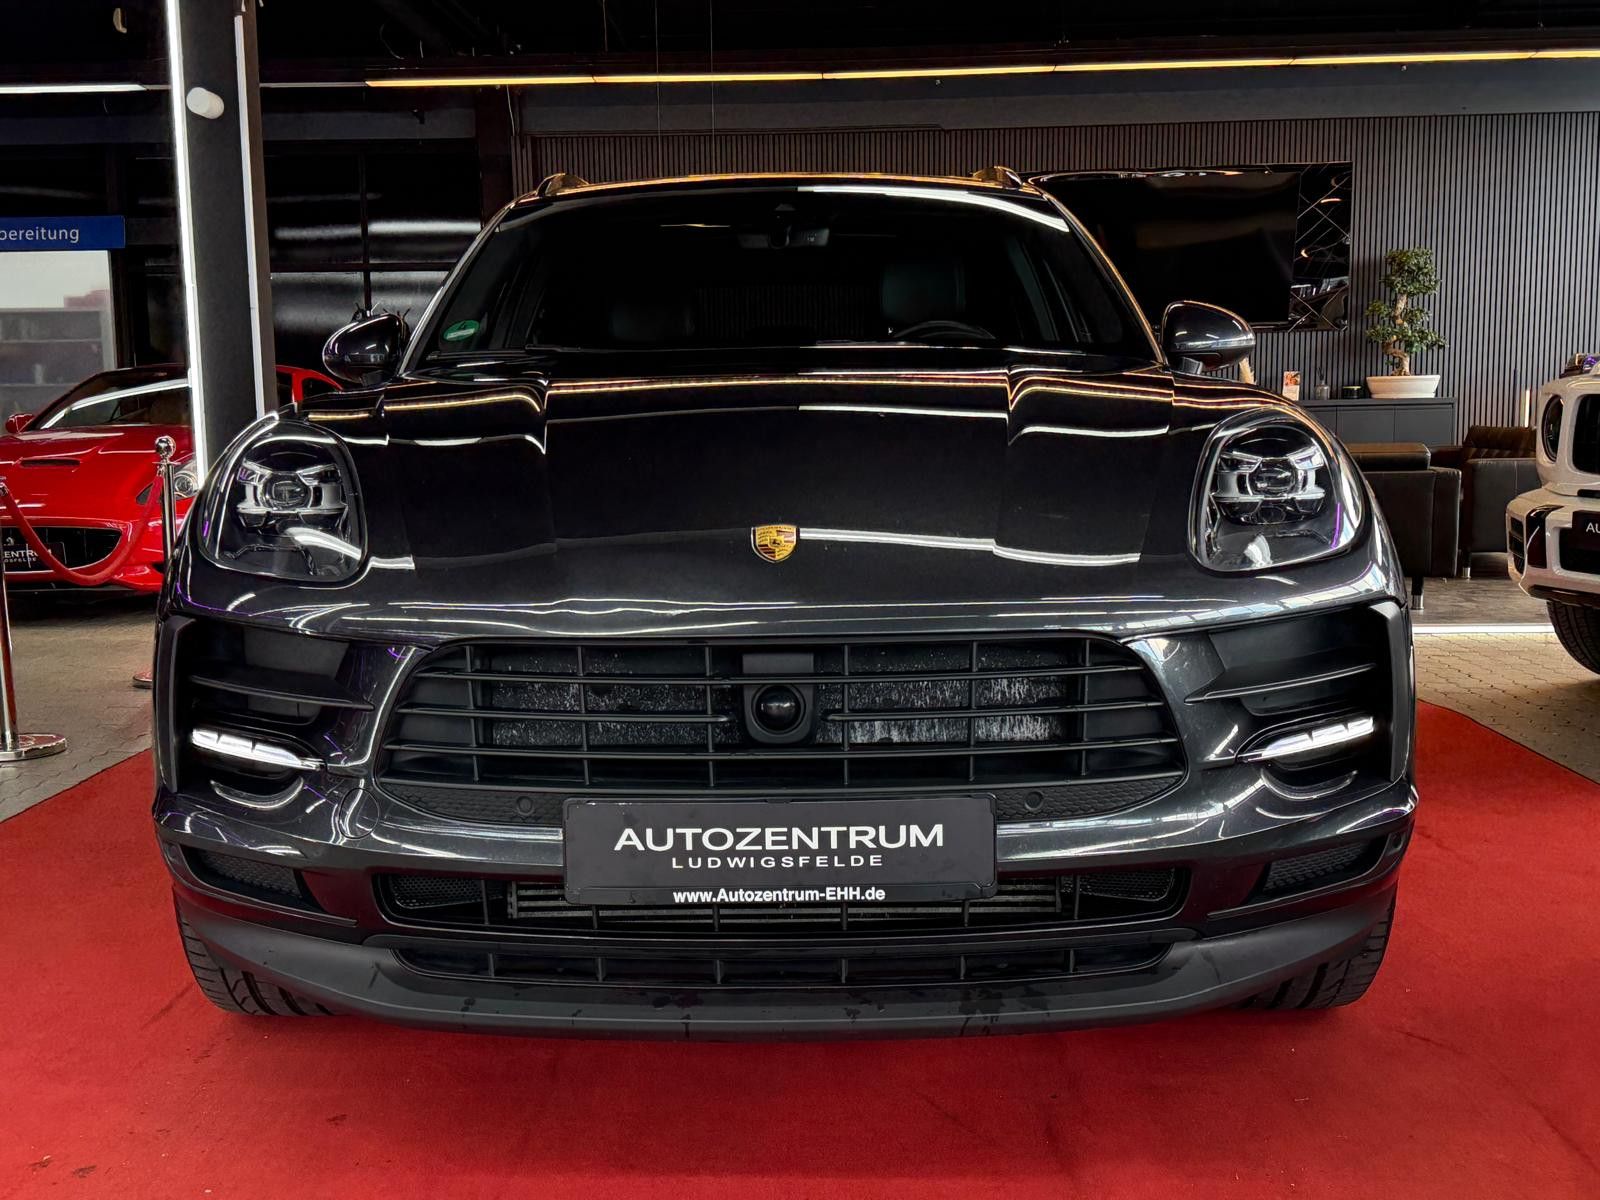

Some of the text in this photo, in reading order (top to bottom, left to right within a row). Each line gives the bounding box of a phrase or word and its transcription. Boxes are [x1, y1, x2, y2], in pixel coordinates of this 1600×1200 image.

[614, 823, 944, 851] AUTOZENTRUM
[672, 855, 883, 869] LUDWIGSFELDE
[673, 886, 886, 904] www.Autozentrum-EHH.de
